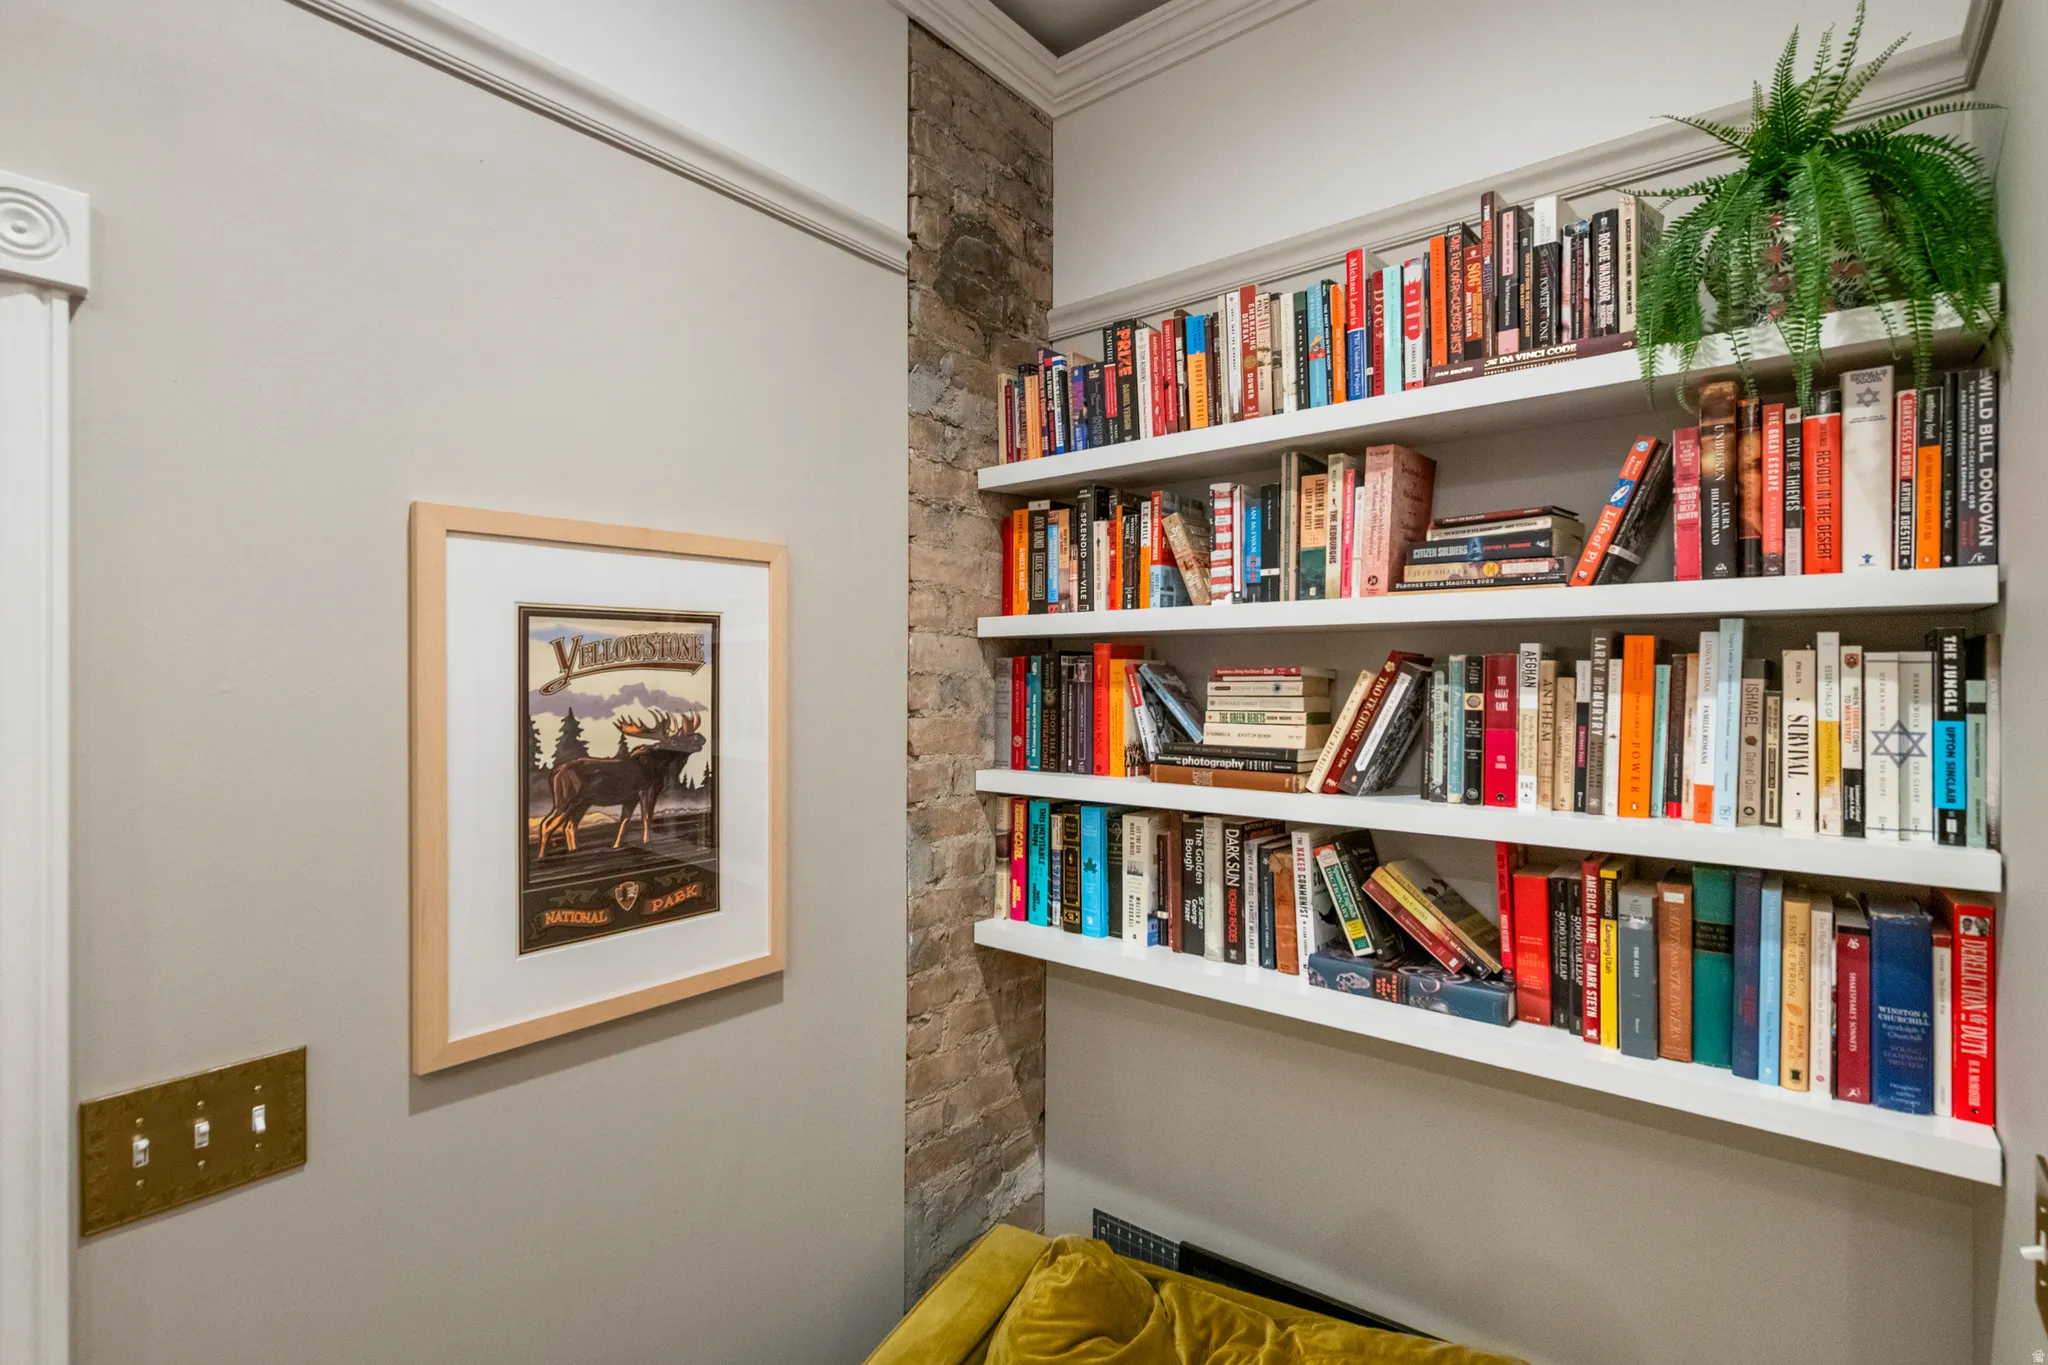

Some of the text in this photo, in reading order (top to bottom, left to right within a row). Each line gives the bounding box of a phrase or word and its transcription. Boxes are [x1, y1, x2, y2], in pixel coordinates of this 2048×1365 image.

[1449, 235, 1461, 251] ONE
[1450, 252, 1461, 271] FLEW
[1349, 257, 1358, 296] Michael
[1467, 262, 1481, 288] SOG
[1598, 231, 1611, 304] ROGUE WARRIOR
[1105, 329, 1114, 363] EMPIRE
[1242, 312, 1250, 344] DEFEAT
[1248, 303, 1256, 351] EMBRACING
[1451, 333, 1462, 354] NEST
[1116, 328, 1132, 377] PRIZE
[1500, 343, 1577, 365] DA VINCI CODE
[1246, 372, 1254, 400] DOWER
[1435, 366, 1474, 378] DAN BROWN
[1714, 424, 1726, 482] UNBROKEN
[1767, 411, 1779, 492] THE GREAT ESCAPE
[1786, 437, 1800, 458] CITY
[1978, 376, 1993, 547] WILD BILL DONOVAN
[1786, 474, 1800, 512] THIEVES
[1900, 398, 1913, 556] DARKNESS AT NOON ARTHUR KOESTLER
[1710, 487, 1720, 546] HILLENBRAND
[1721, 502, 1730, 530] LAURA
[1815, 449, 1832, 560] REVOLT IN THE DESERT
[1033, 530, 1045, 549] RAND
[1080, 512, 1088, 600] SPLENDID VILE
[1329, 510, 1338, 564] THE JEDBURGHS
[1584, 511, 1617, 563] Life of Pi
[540, 632, 707, 695] YELLOWSTONE
[1524, 650, 1537, 688] AFGHAN
[1703, 666, 1712, 692] LATINA
[1943, 635, 1958, 713] THE JUNGLE
[1592, 637, 1607, 736] LARRY McMURTRY
[1744, 683, 1759, 728] ISHMAEL
[1350, 676, 1389, 742] TAO TE CHING
[1541, 679, 1552, 742] ANTHEM
[1182, 755, 1244, 770] photography
[1700, 734, 1709, 765] ROMANA
[1787, 714, 1809, 779] SURVIVAL
[1945, 726, 1956, 804] UPTON SINCLAIR
[1630, 741, 1641, 794] POWER
[1037, 808, 1046, 865] THIS INEVITABLE
[1184, 838, 1194, 871] Bough
[1195, 828, 1204, 884] The Golden
[1225, 829, 1240, 887] DARK SUN
[1296, 846, 1306, 872] NAKED
[652, 884, 698, 913] PARK
[1190, 899, 1198, 925] George
[1298, 874, 1308, 918] COMMUNIST
[545, 909, 607, 926] NATIONAL
[1558, 936, 1567, 958] YEAR
[1574, 941, 1583, 964] YEAR
[1586, 875, 1598, 1018] AMERICA ALONE MARK STEYN
[1603, 924, 1613, 956] Camping
[1797, 932, 1806, 982] THE HIGHLY
[1559, 958, 1568, 980] LEAP
[1575, 964, 1584, 986] LEAP
[1787, 961, 1796, 997] PERSON
[1878, 1005, 1921, 1017] WINSTON
[1960, 938, 1988, 1059] DERELICTION DUTY
[1878, 1014, 1928, 1026] CHURCHILL
